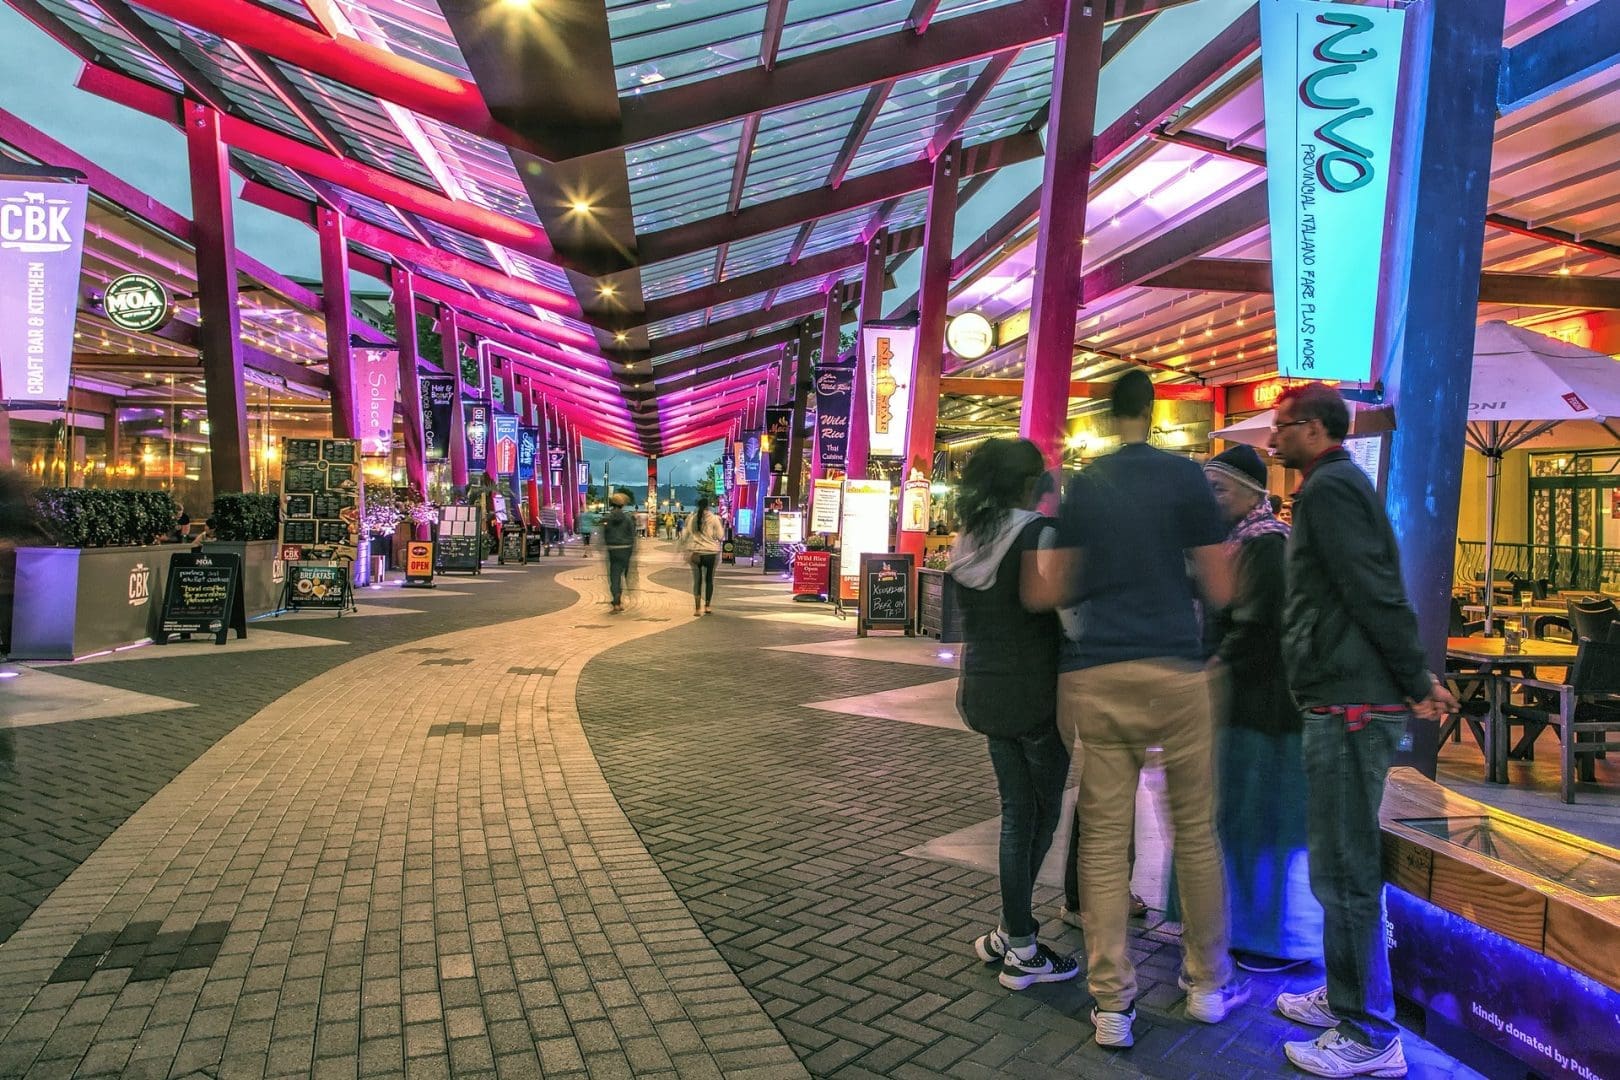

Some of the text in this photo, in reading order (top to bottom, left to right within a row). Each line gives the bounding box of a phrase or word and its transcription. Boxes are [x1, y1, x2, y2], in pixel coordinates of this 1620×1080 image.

[0, 204, 72, 242] CBK
[1301, 144, 1315, 370] PROVINCIAL ITALIANO FARE PLUS MORE
[106, 288, 163, 313] MOA
[27, 262, 44, 394] CRAFT BAR & KITCHEN
[369, 371, 386, 427] Solace
[820, 414, 847, 426] Wild
[821, 428, 846, 439] Rice
[826, 444, 839, 453] Thai
[284, 550, 299, 558] CBK
[411, 561, 429, 570] OPEN
[129, 571, 150, 599] CBK
[300, 572, 335, 580] BREAKFAST
[1472, 1001, 1504, 1031] kindly
[1505, 1022, 1552, 1058] donated
[1554, 1048, 1569, 1069] by
